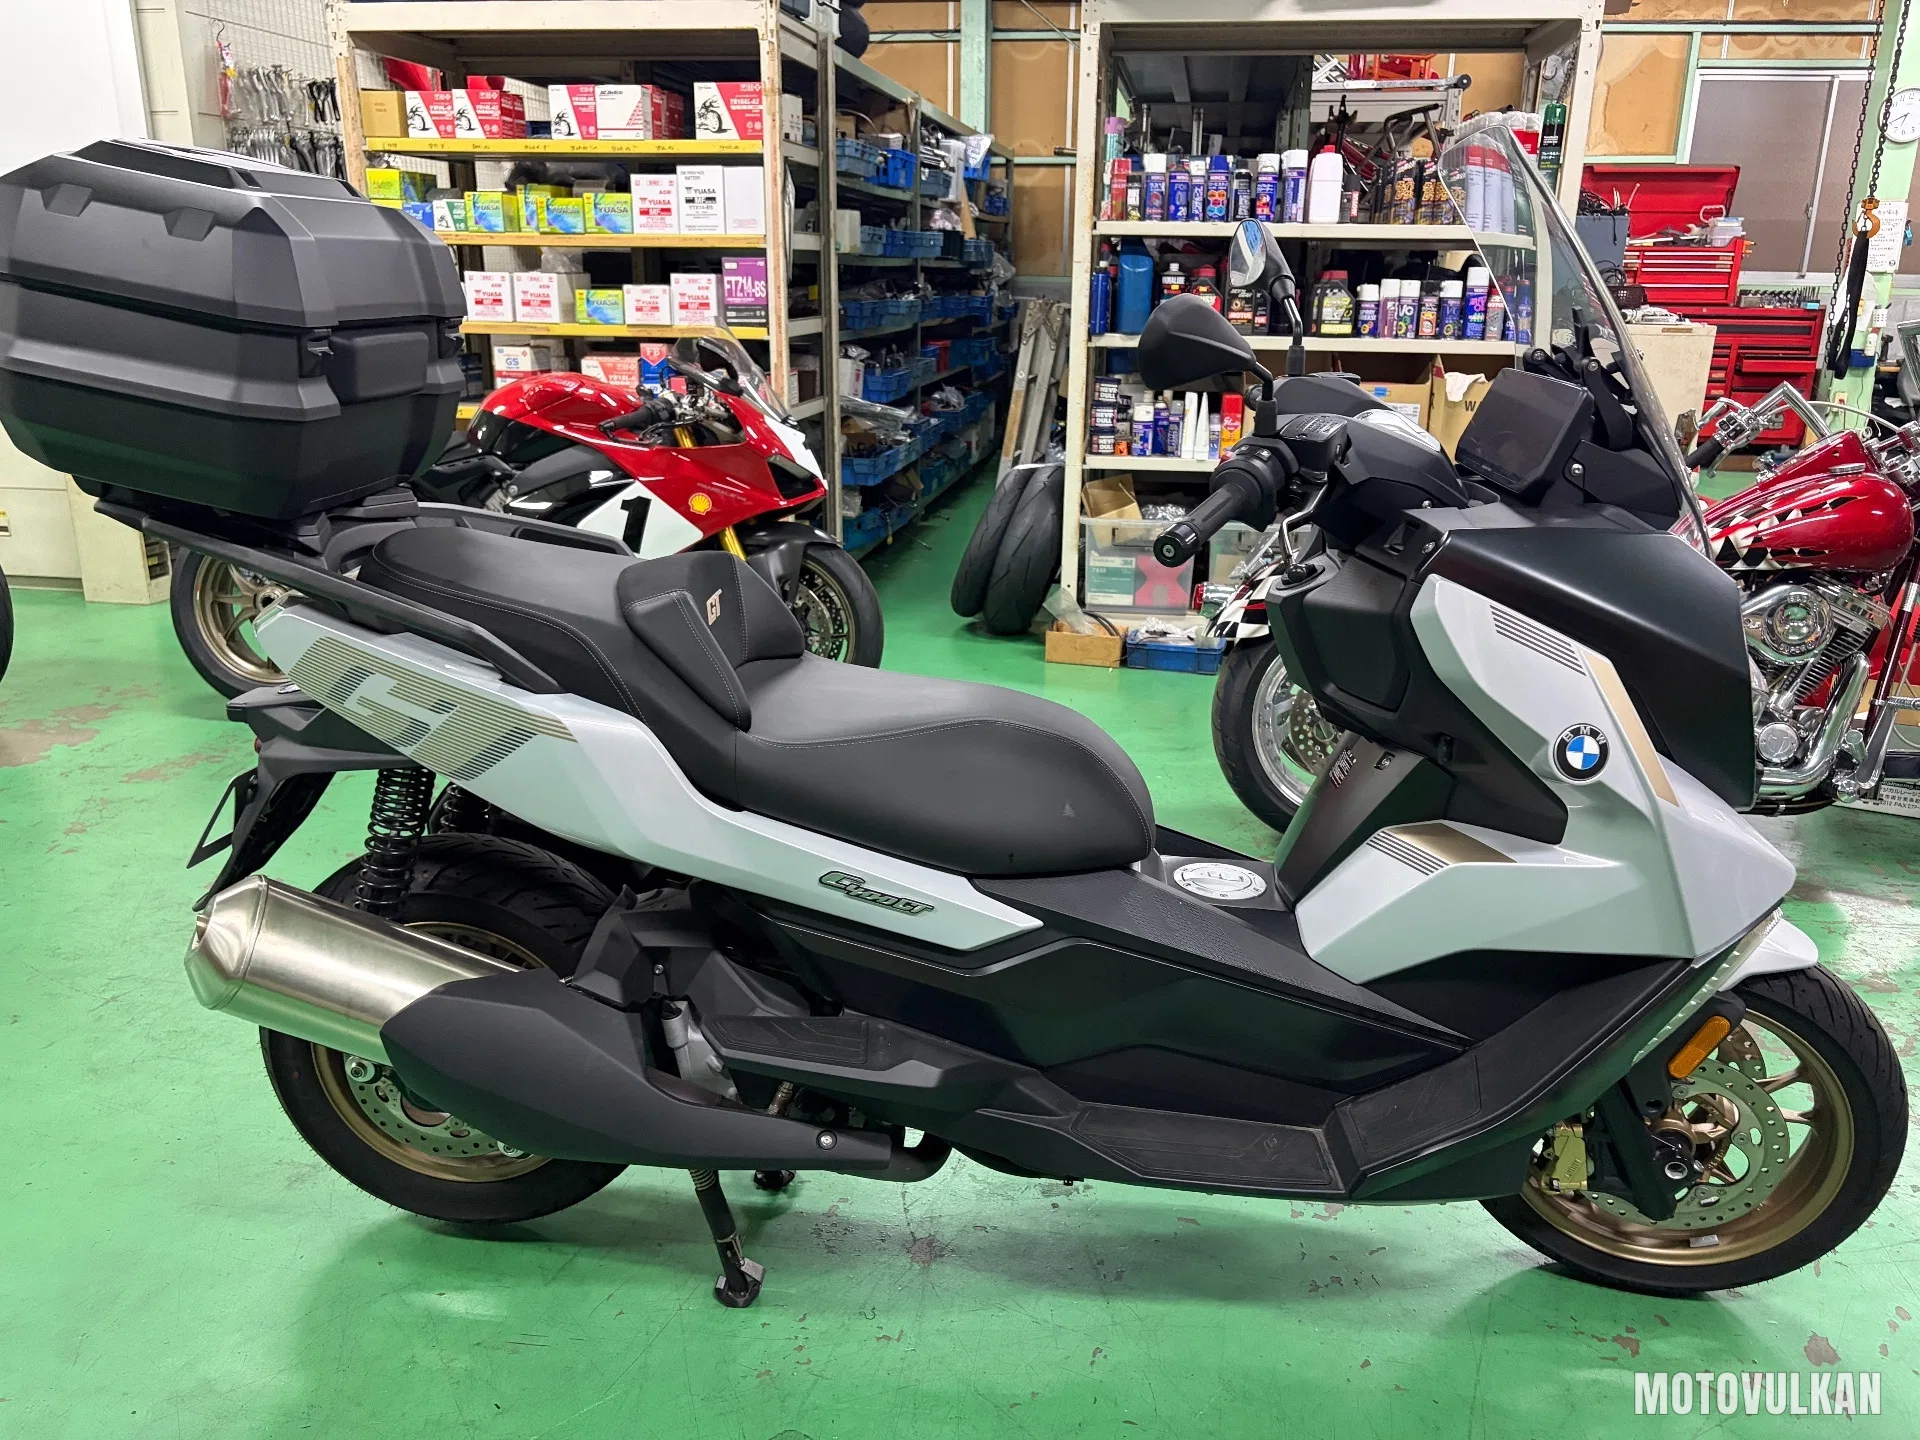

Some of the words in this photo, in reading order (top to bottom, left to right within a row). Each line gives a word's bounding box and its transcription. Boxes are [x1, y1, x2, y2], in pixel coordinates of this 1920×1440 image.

[548, 205, 580, 213] YUASA
[598, 206, 629, 214] YUASA
[723, 276, 767, 298] FTZ14-BS
[505, 358, 519, 366] GS
[1464, 400, 1477, 412] W
[619, 495, 652, 554] 1
[1562, 725, 1607, 745] BMW
